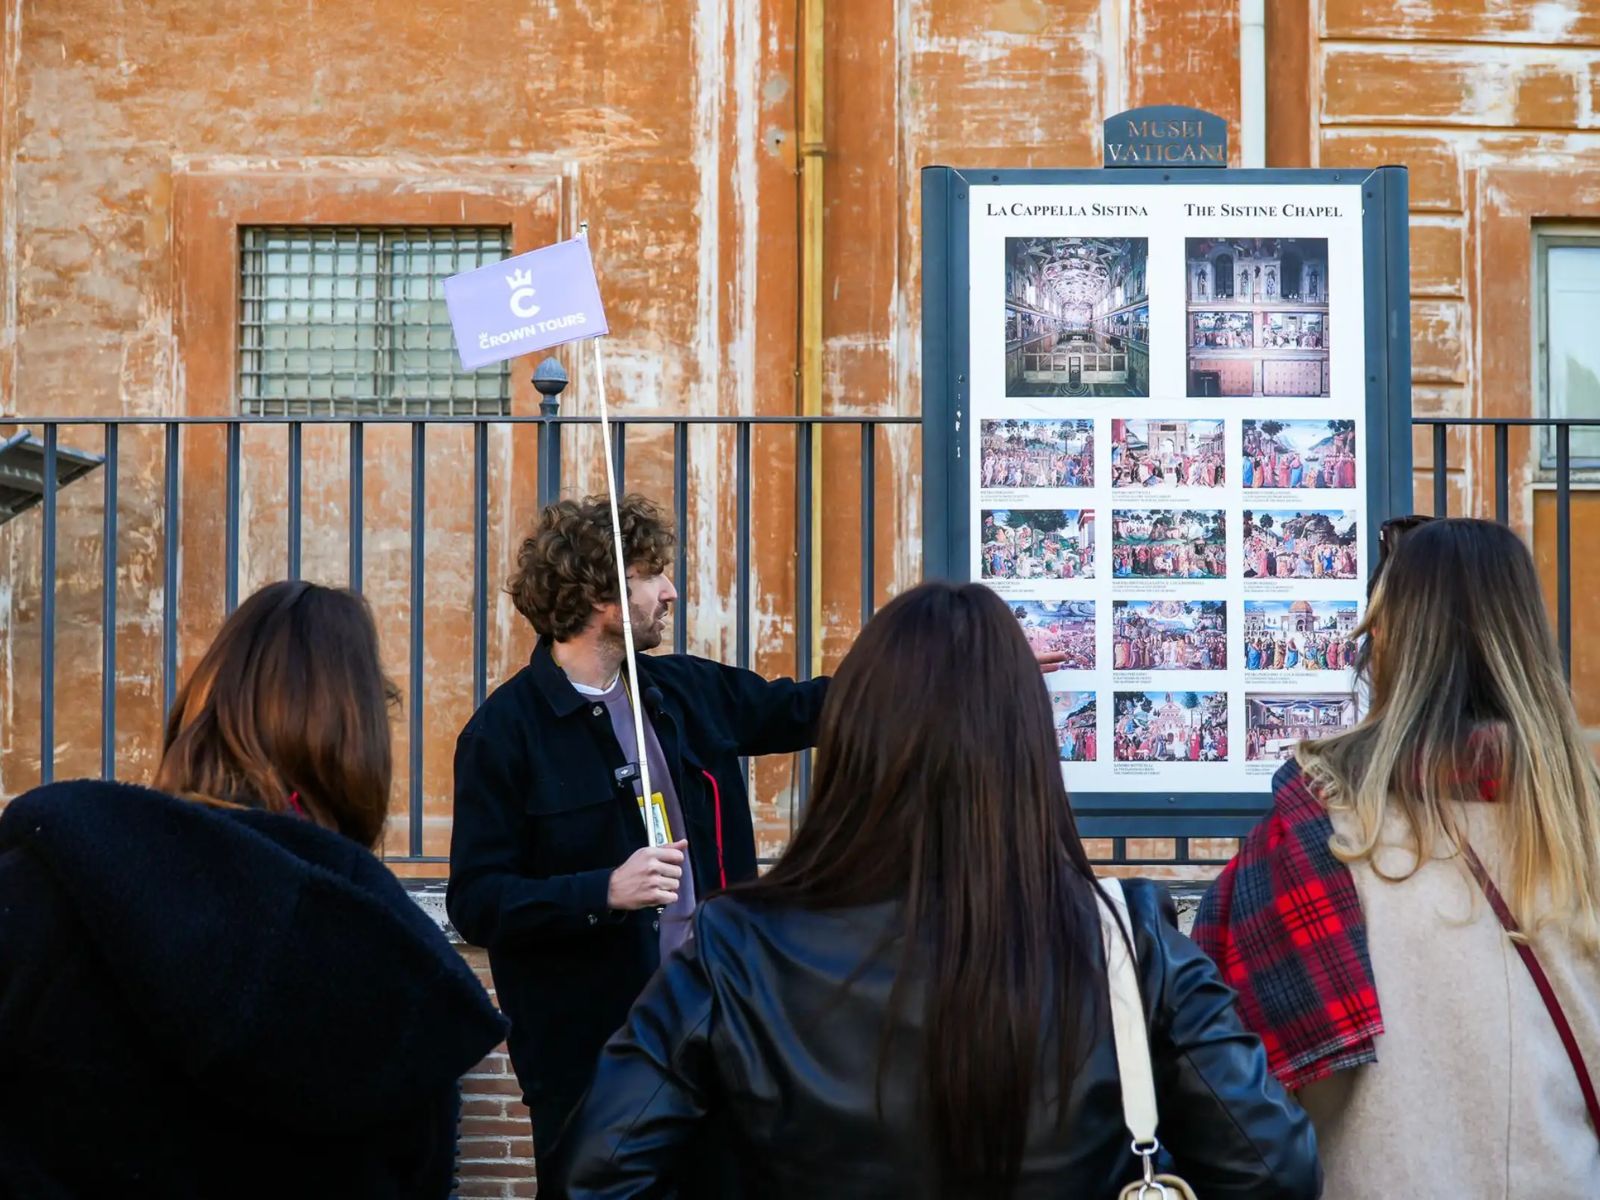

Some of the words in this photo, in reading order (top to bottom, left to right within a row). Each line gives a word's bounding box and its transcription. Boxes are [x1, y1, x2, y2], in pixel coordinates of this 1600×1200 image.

[1127, 120, 1203, 138] MUSEI
[1107, 143, 1224, 161] VATICANI
[1010, 203, 1087, 217] CAPPELLA
[1092, 203, 1149, 217] SISTINA
[1184, 203, 1216, 217] THE
[1220, 203, 1278, 217] SISTINE
[1282, 203, 1343, 218] CHAPEL
[479, 325, 536, 349] CROWN
[537, 312, 587, 334] TOURS
